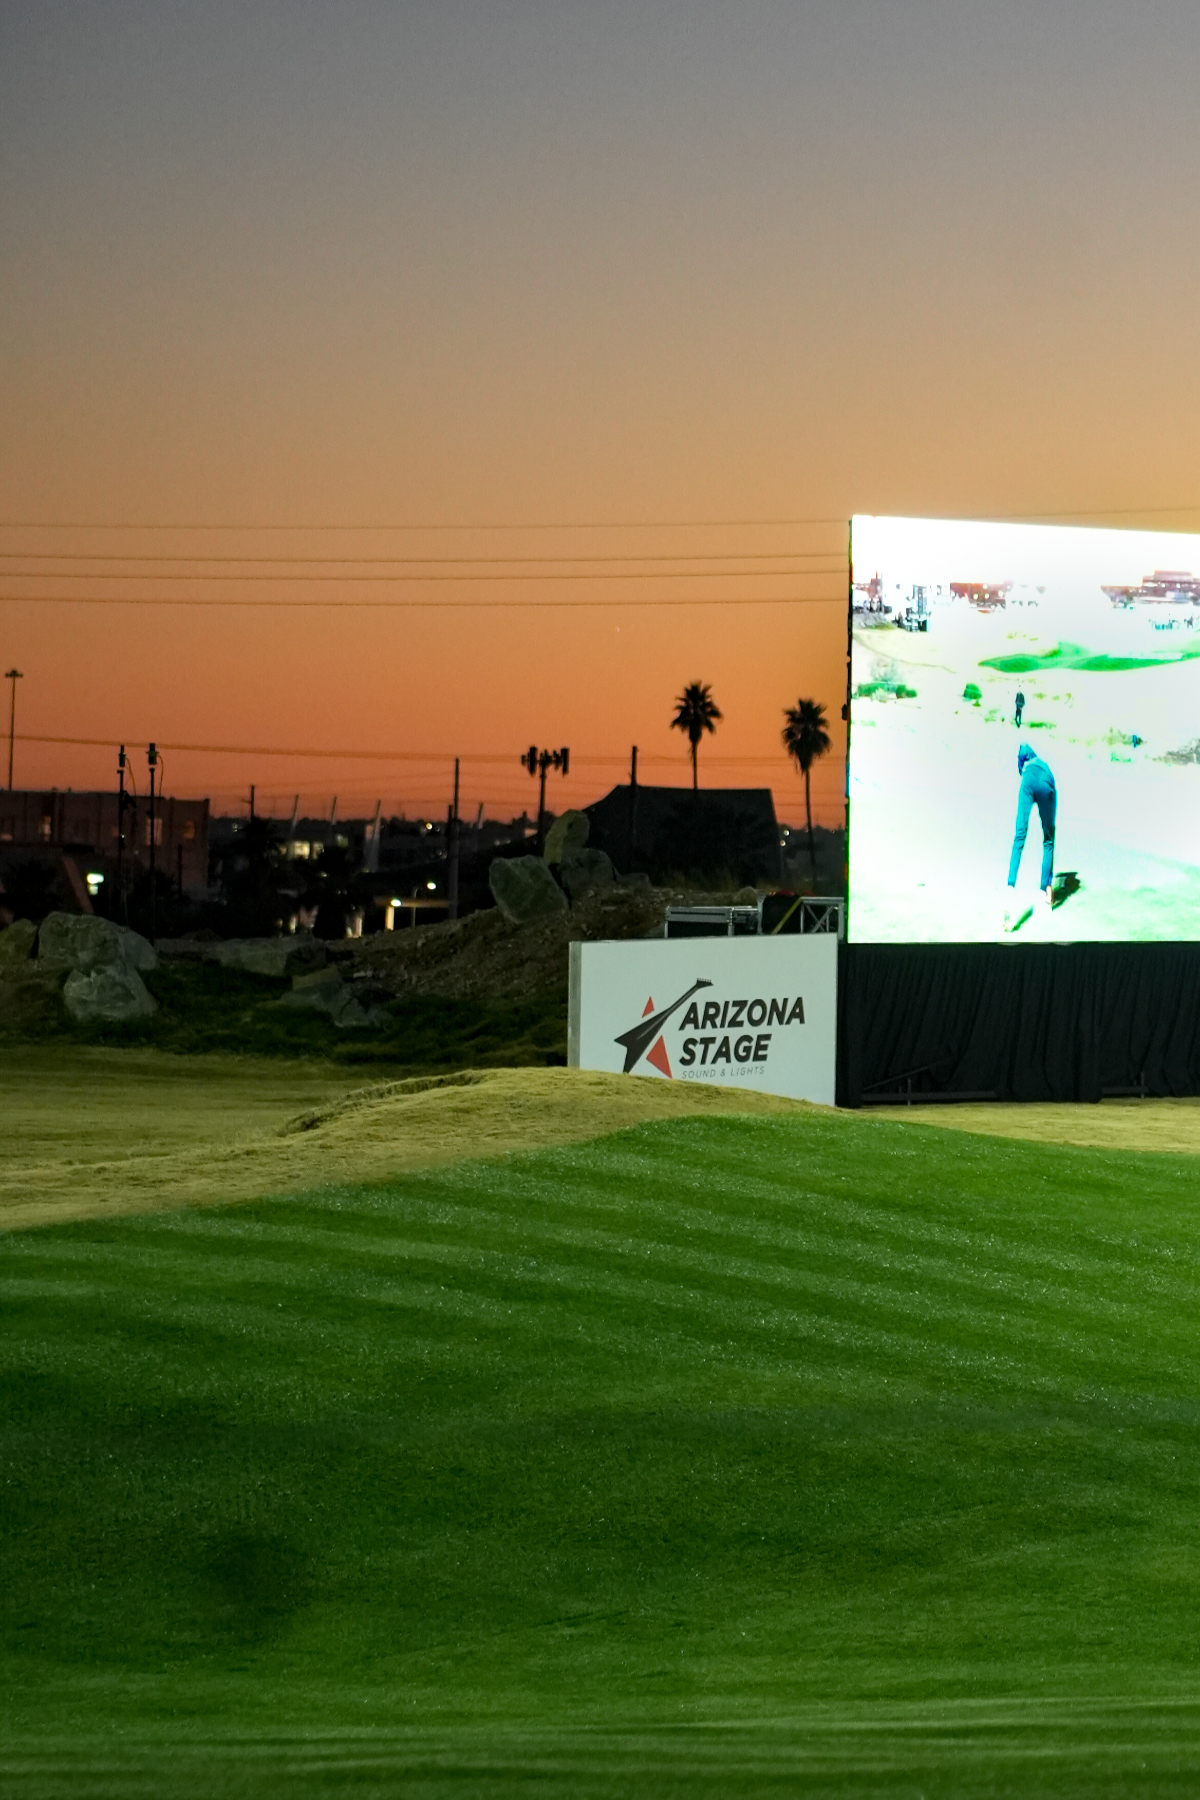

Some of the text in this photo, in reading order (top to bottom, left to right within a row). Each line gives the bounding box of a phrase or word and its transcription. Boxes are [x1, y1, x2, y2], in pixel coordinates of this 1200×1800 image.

[678, 996, 806, 1031] ARIZONA
[679, 1034, 772, 1066] STAGE
[682, 1066, 765, 1079] SOUND & LIGHTS
